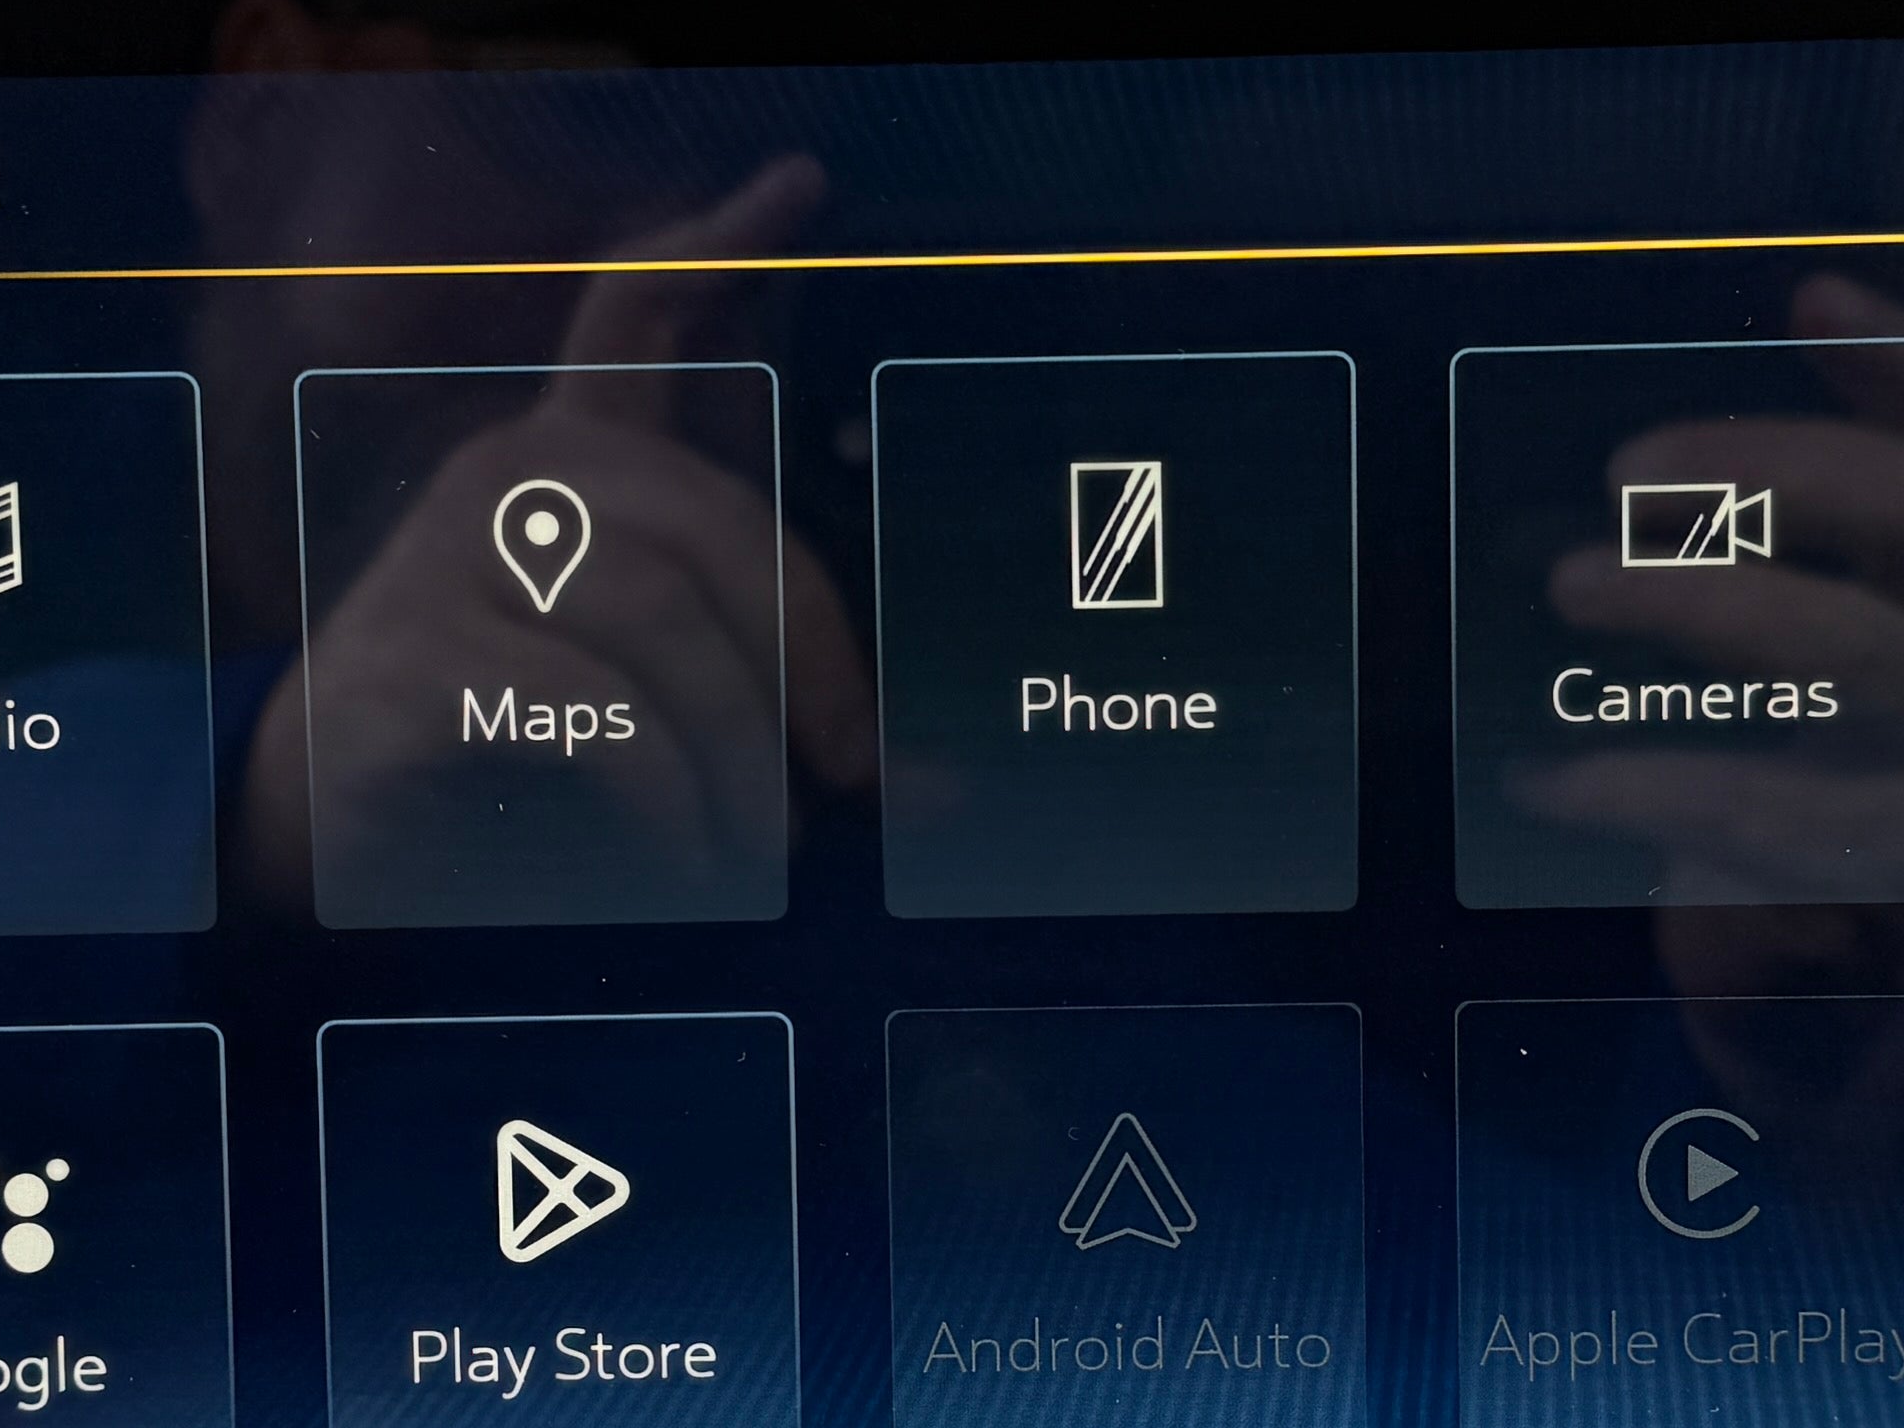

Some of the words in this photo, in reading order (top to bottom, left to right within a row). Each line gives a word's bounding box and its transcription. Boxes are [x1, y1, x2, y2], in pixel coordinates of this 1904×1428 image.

[461, 687, 636, 758] Maps
[1020, 673, 1218, 733] Phone
[1551, 667, 1840, 723] Cameras
[411, 1326, 536, 1399] Play
[554, 1326, 718, 1382] Store
[922, 1315, 1164, 1375] Android
[1184, 1317, 1332, 1371] Auto
[1478, 1309, 1658, 1382] Apple
